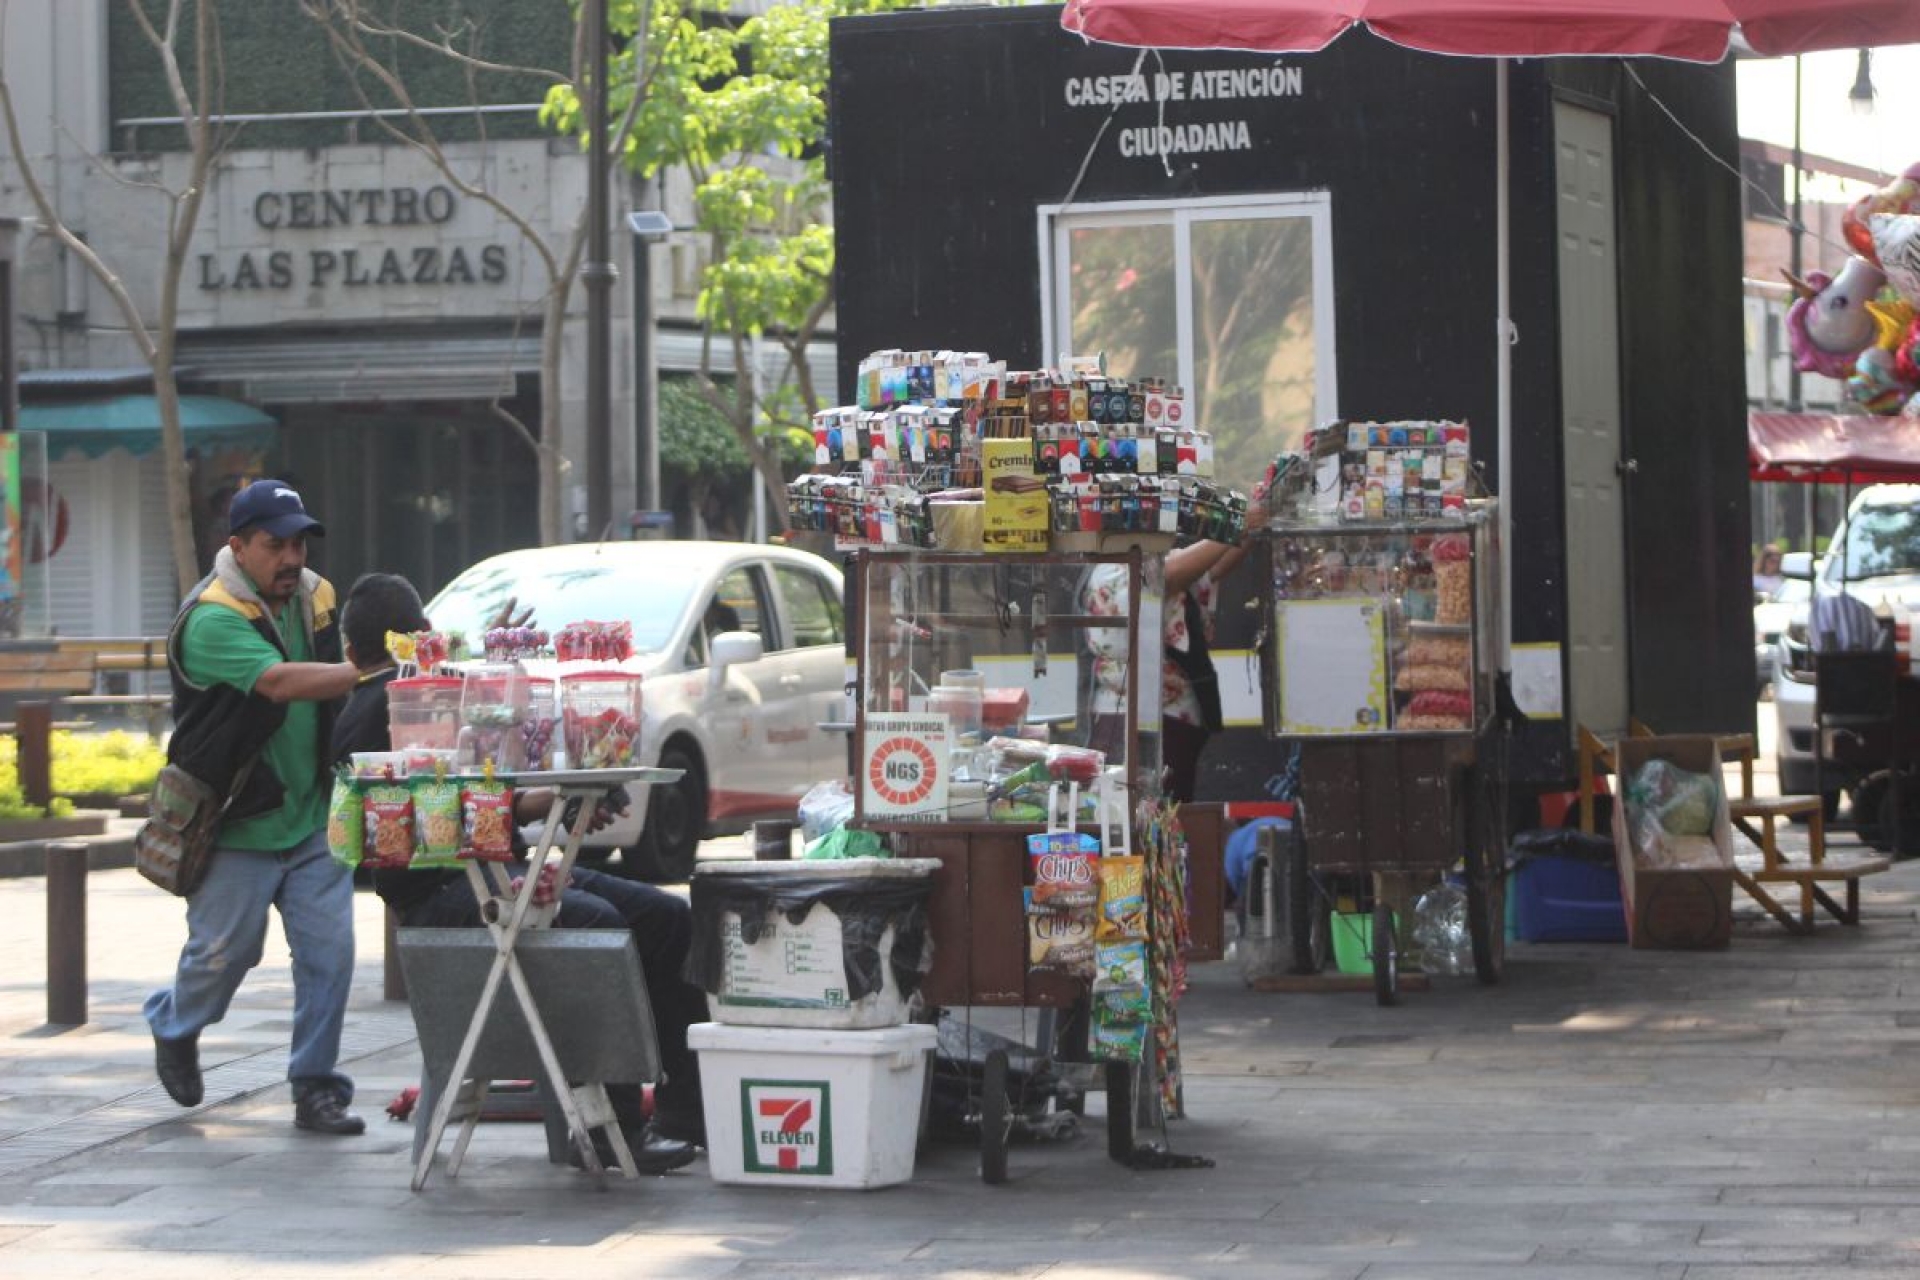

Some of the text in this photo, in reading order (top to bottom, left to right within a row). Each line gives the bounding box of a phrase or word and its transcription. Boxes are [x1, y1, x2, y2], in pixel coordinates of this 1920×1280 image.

[1065, 59, 1302, 106] CASETA DE ATENCIÓN
[1119, 121, 1251, 157] CIUDADANA
[255, 185, 456, 229] CENTRO
[199, 245, 508, 291] LAS PLAZAS
[885, 761, 919, 780] NGS
